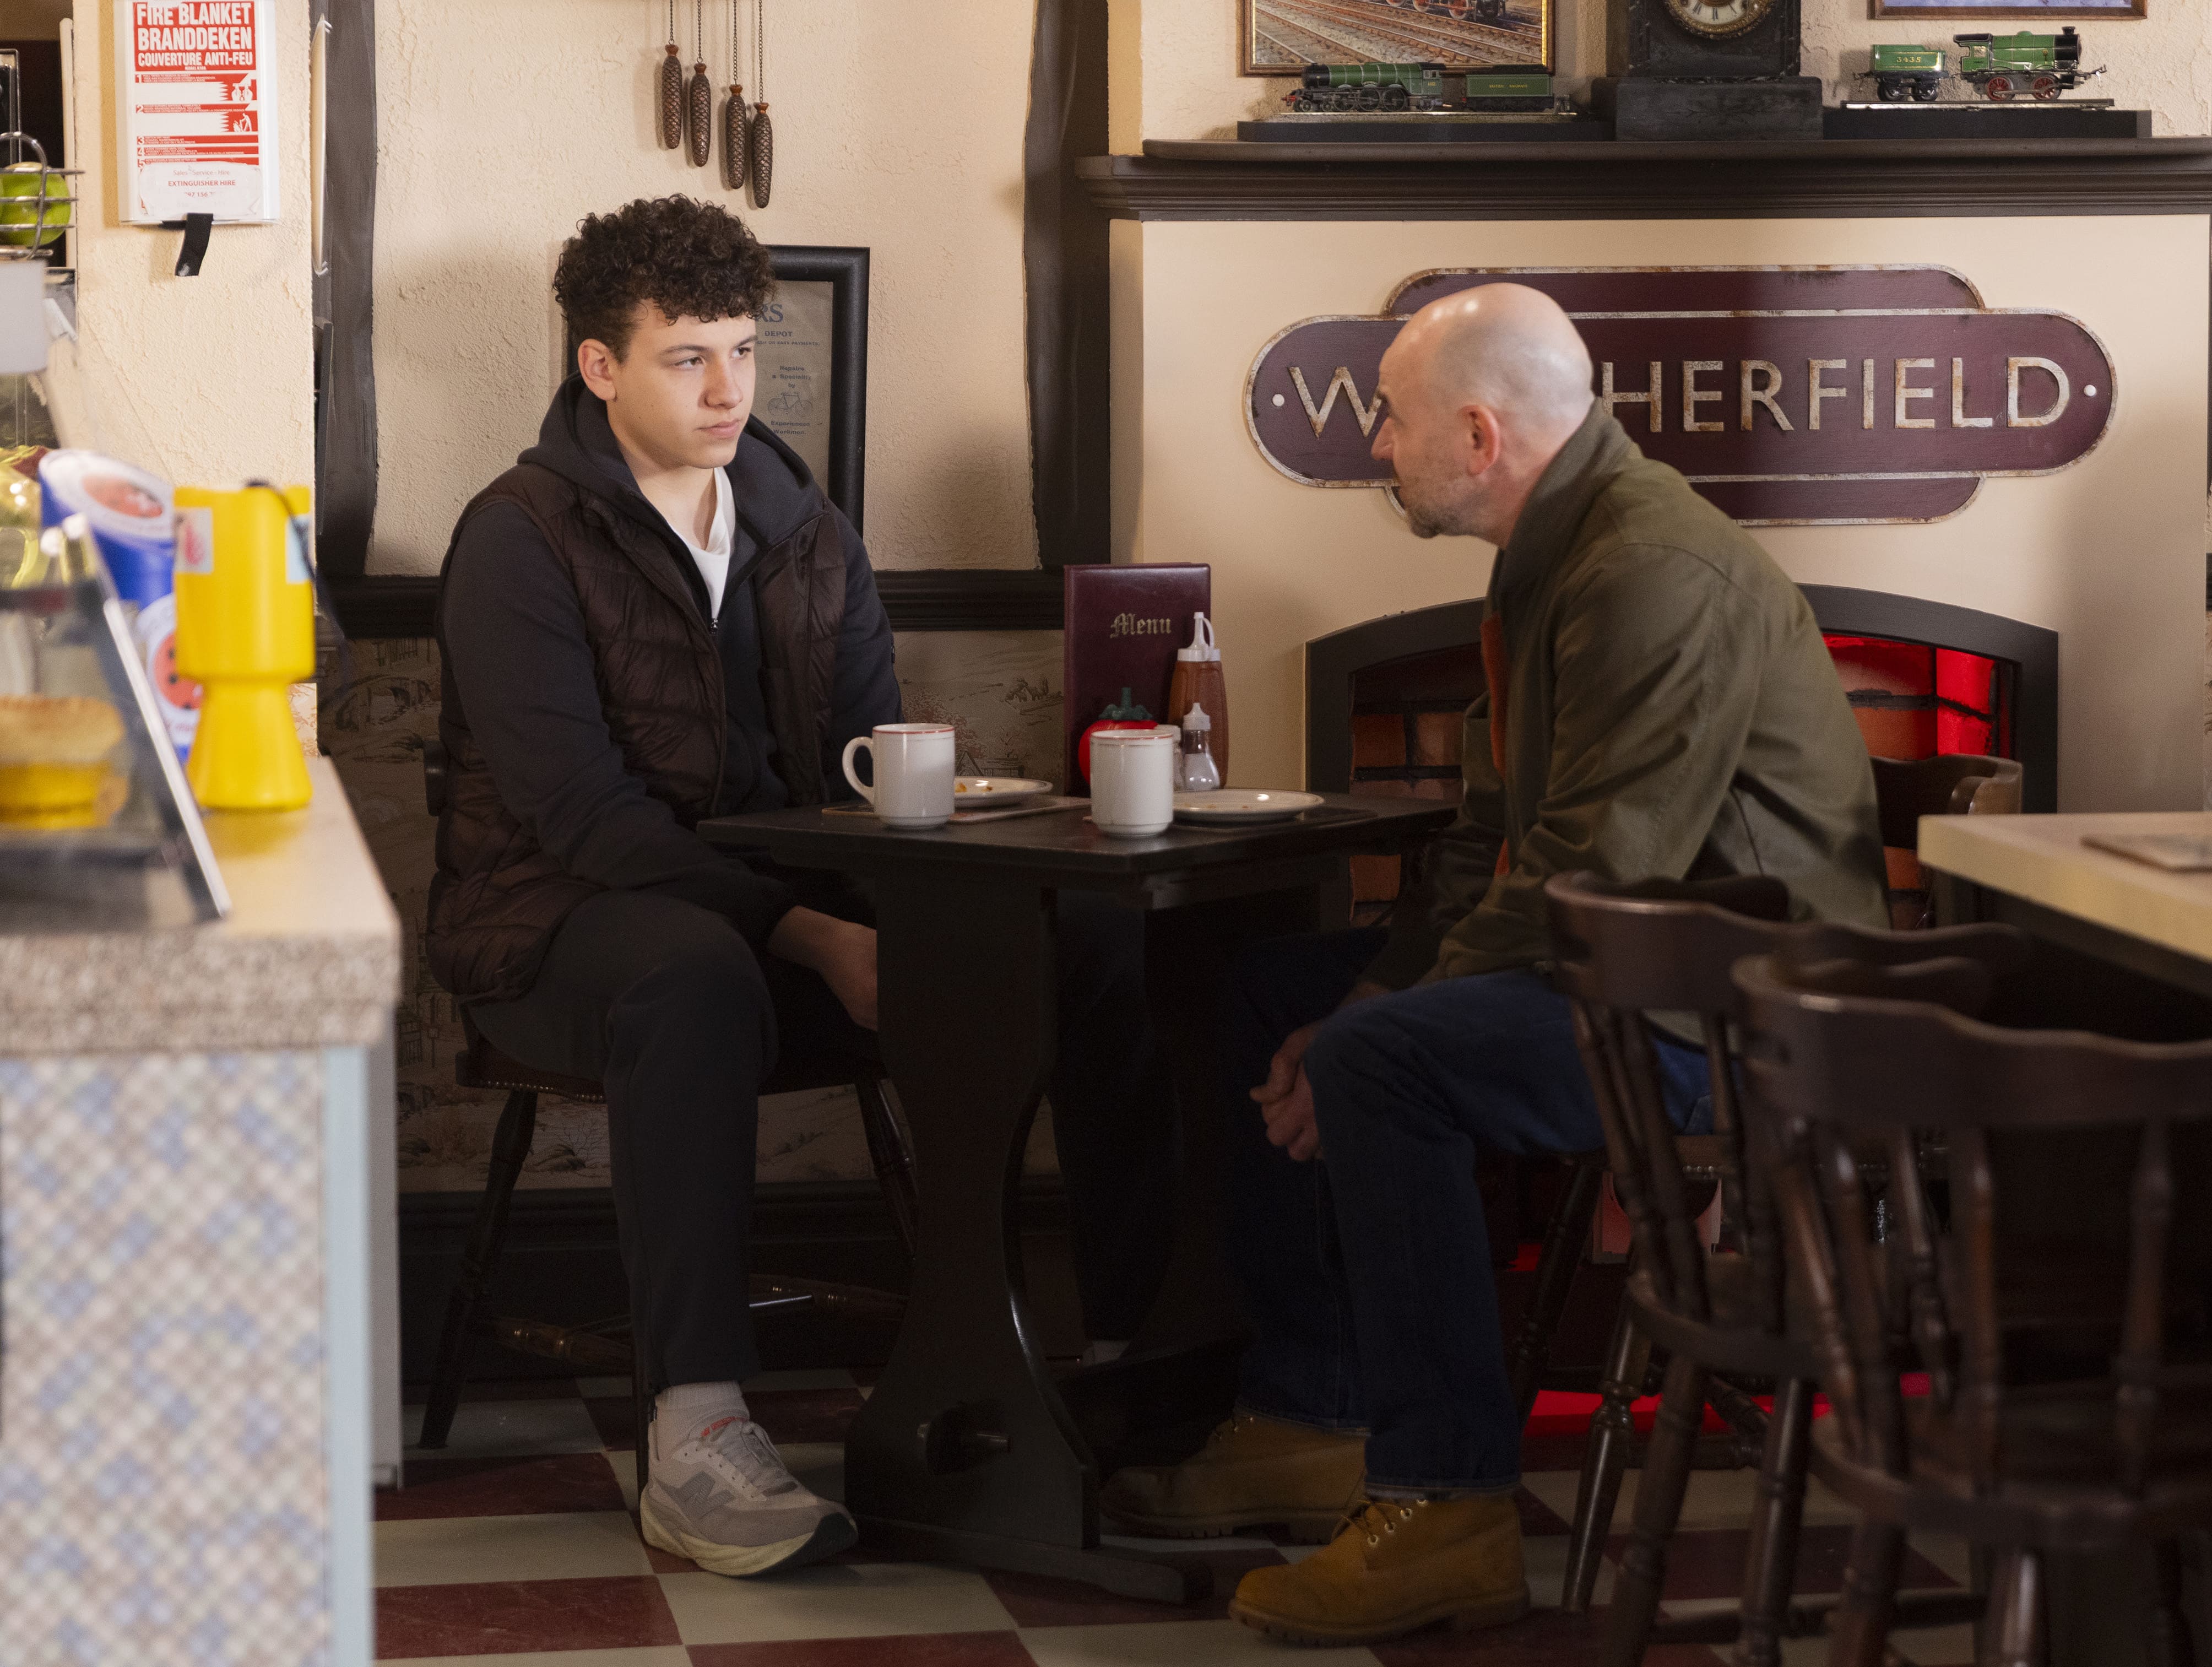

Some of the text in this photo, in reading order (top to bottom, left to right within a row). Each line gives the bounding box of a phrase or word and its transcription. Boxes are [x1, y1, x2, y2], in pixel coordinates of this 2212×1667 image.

[137, 2, 251, 25] FIRE BLANKET
[138, 26, 252, 51] BRANDDEKEN
[138, 51, 253, 67] COUVERTURE ANTI-FEU
[137, 74, 142, 83] 1
[137, 105, 144, 113] 2
[138, 137, 145, 145] 3
[138, 147, 145, 156] 4
[1287, 356, 2070, 439] WHERFIELD
[1110, 613, 1172, 638] Menu
